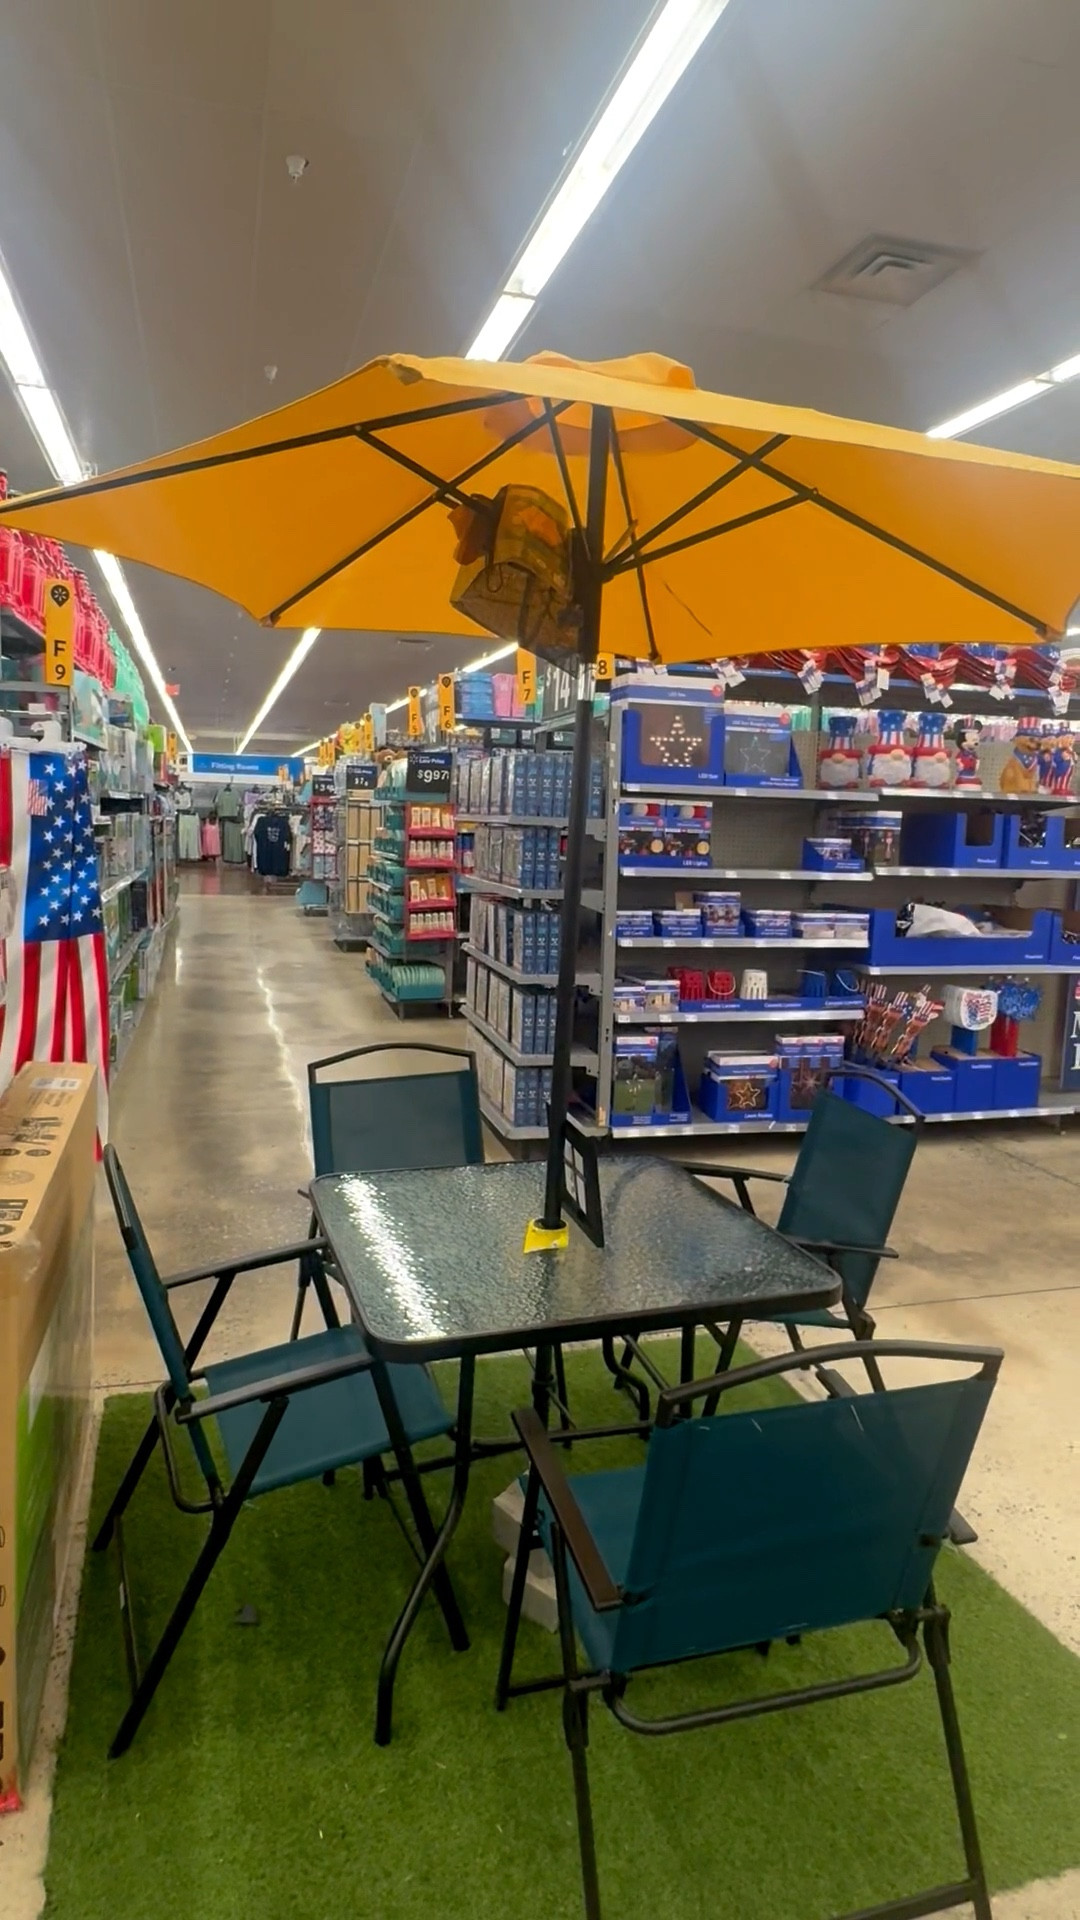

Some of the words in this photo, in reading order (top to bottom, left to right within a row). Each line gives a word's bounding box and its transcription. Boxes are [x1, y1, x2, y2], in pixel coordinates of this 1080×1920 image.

[53, 640, 66, 657] F
[55, 664, 66, 680] 9
[598, 659, 607, 675] 8
[522, 671, 531, 684] F
[523, 688, 531, 701] 7
[443, 706, 451, 716] F
[444, 720, 451, 729] 6
